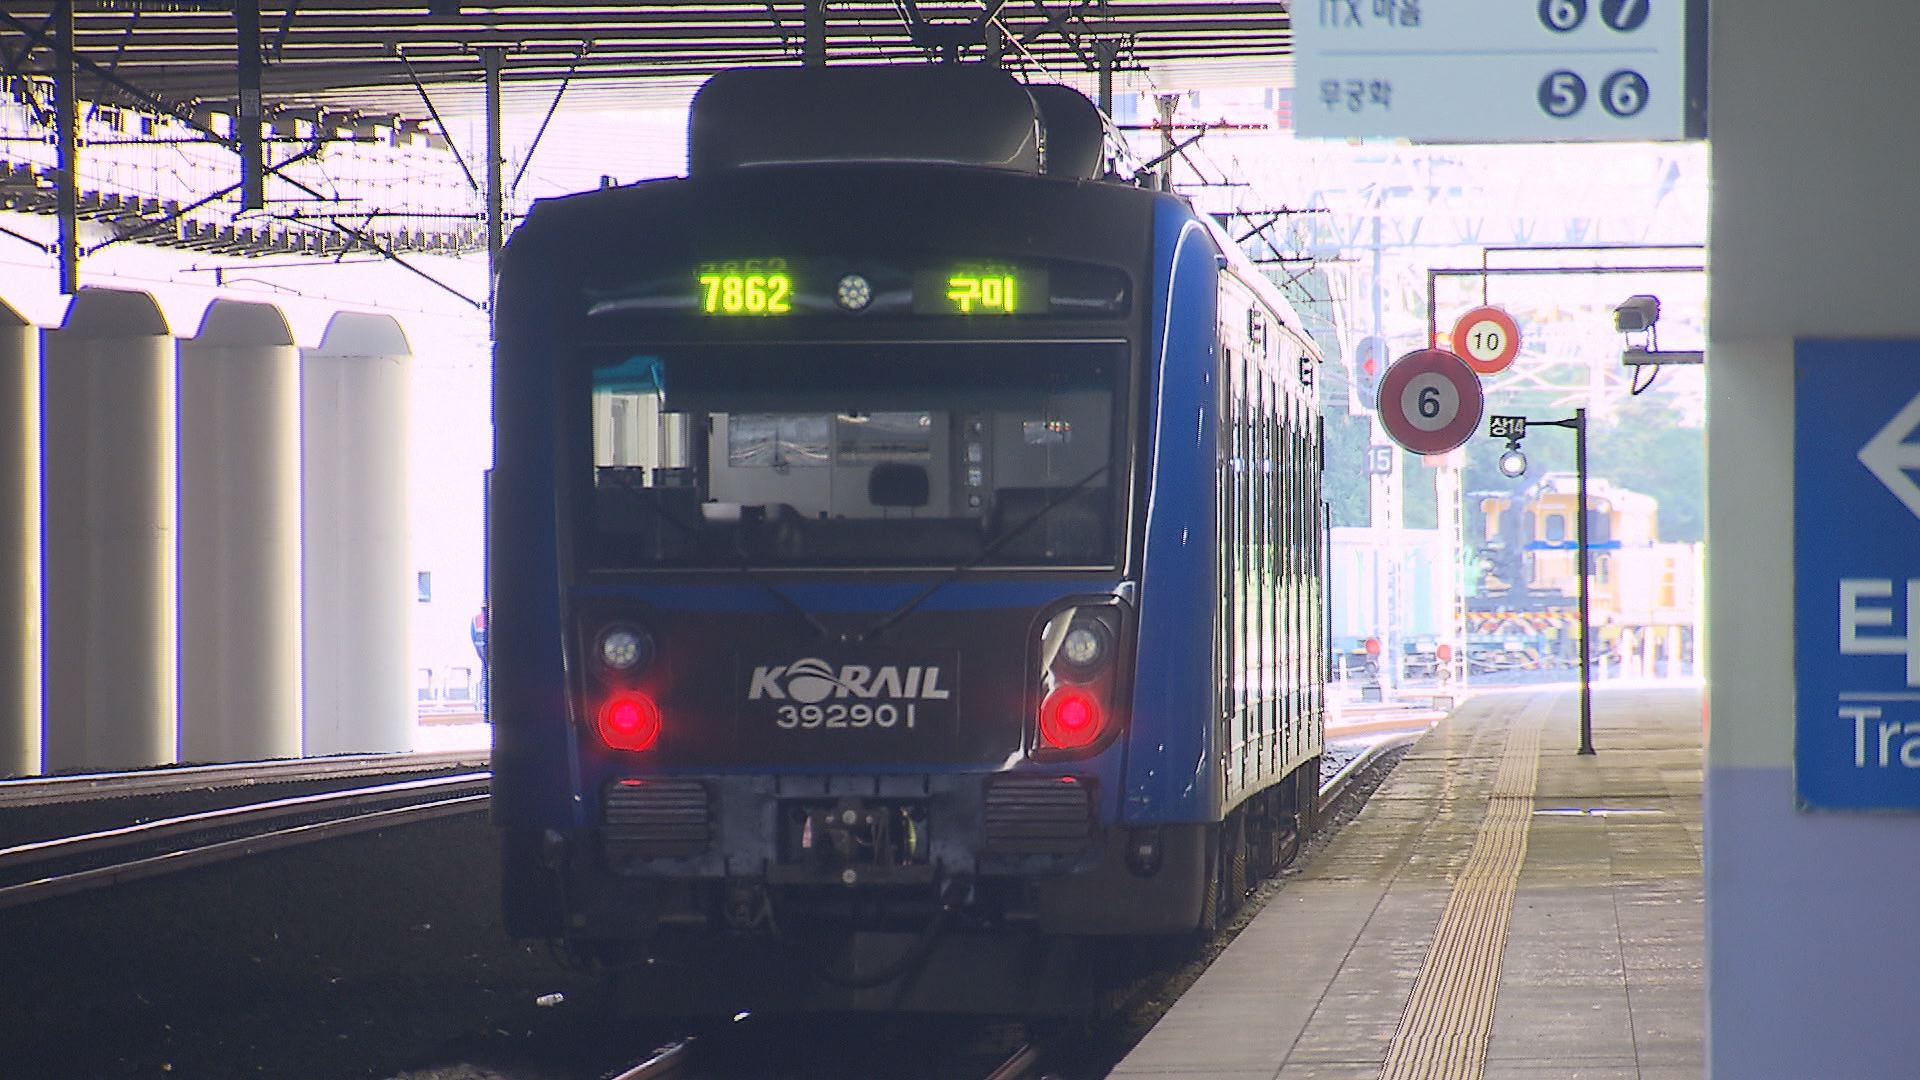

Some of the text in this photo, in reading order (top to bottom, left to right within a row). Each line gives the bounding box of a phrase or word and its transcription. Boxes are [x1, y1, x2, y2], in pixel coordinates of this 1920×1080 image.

[1547, 0, 1578, 29] 6
[1549, 75, 1577, 115] 5
[1610, 75, 1639, 115] 6
[698, 272, 792, 314] 7862
[946, 275, 1016, 314] 구미
[1474, 332, 1499, 351] 10
[1418, 386, 1441, 418] 6
[1491, 417, 1525, 436] 상14
[1367, 448, 1392, 471] 15
[748, 657, 950, 704] KORAIL
[776, 703, 915, 729] 392901
